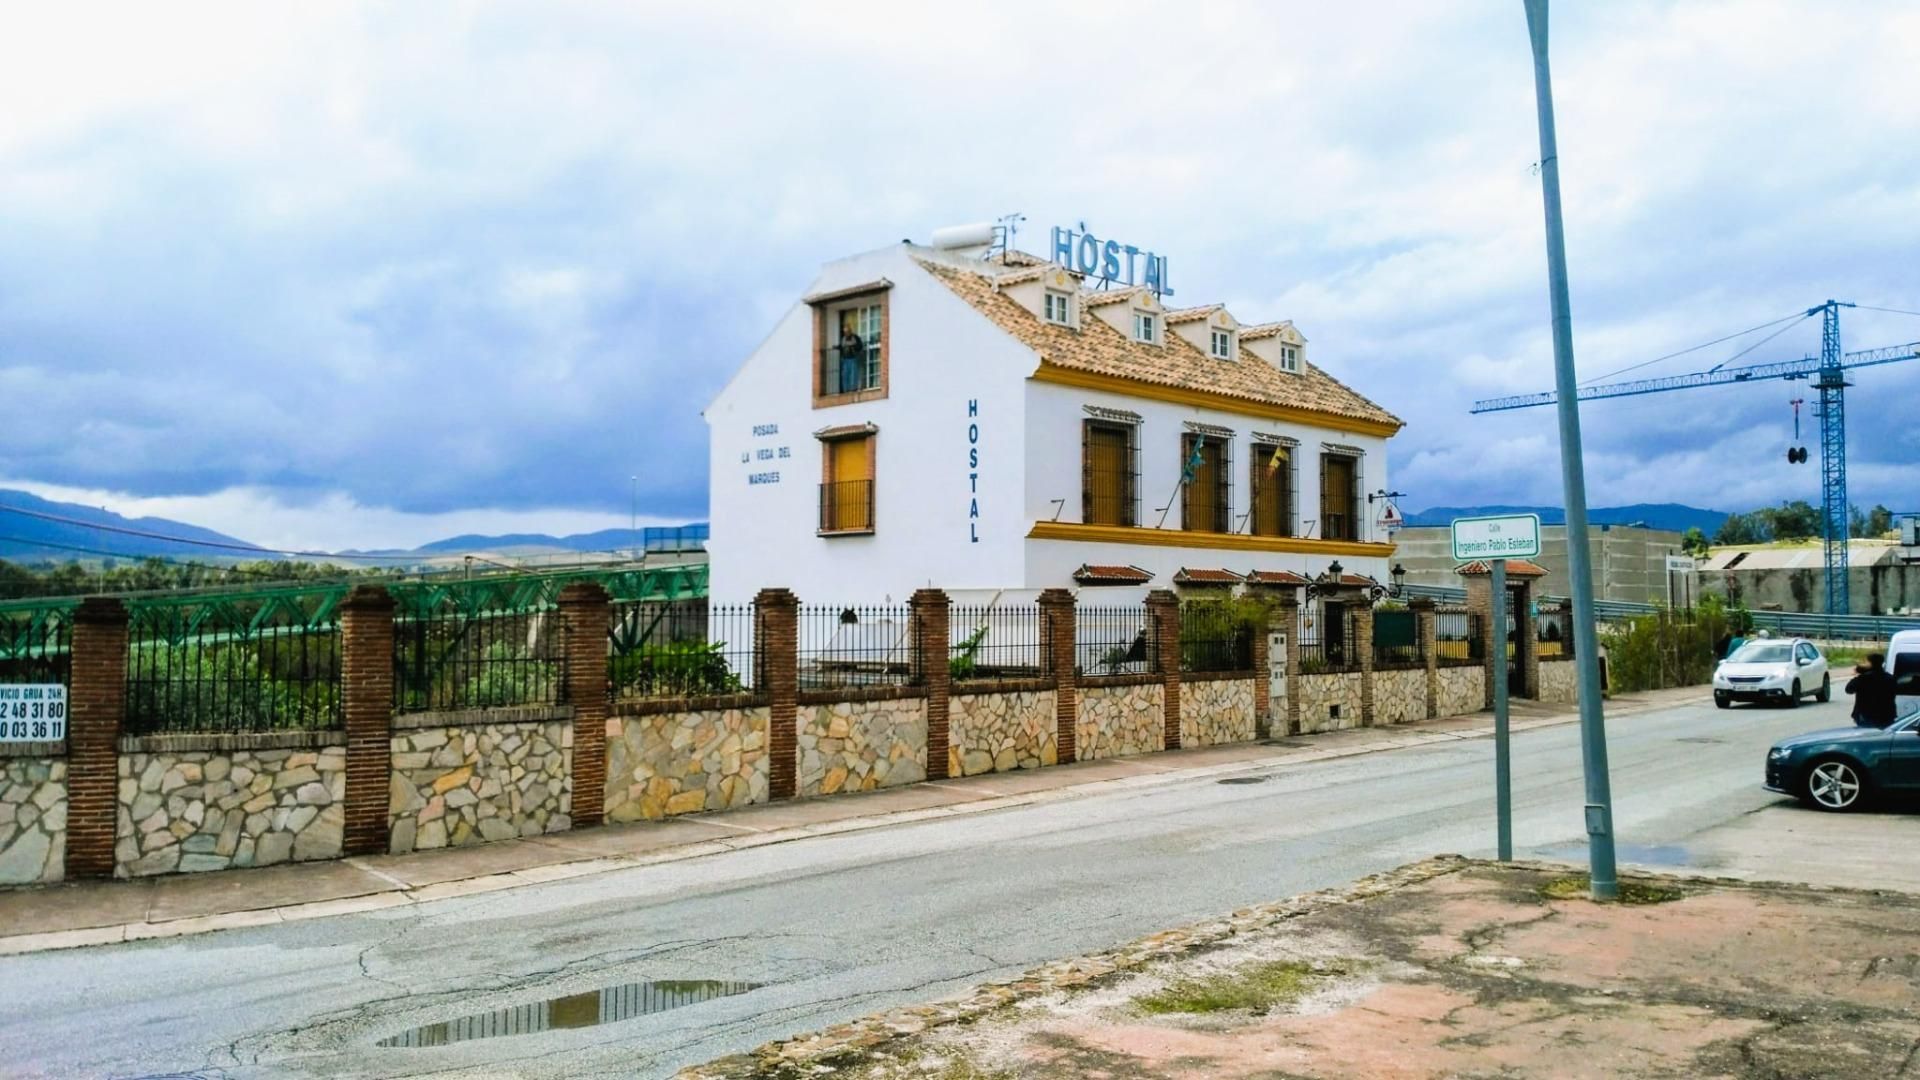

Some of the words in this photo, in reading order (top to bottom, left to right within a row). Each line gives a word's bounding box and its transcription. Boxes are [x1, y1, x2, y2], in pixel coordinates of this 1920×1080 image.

[1051, 226, 1174, 296] HOSTAL
[753, 424, 778, 436] POSADA
[742, 452, 750, 463] LA
[757, 449, 773, 460] VEGA
[779, 447, 791, 458] DEL
[749, 472, 779, 484] MARQUES
[968, 398, 979, 543] HOSTAL
[1488, 523, 1500, 532] Calle
[1458, 540, 1487, 554] Ingeniero
[1489, 539, 1506, 550] Pablo
[1508, 538, 1534, 550] Esteban
[23, 688, 43, 700] GRUA
[12, 702, 27, 719] 48
[31, 702, 44, 719] 31
[48, 702, 64, 719] 80
[12, 721, 27, 738] 03
[31, 721, 47, 738] 36
[52, 721, 62, 738] 11
